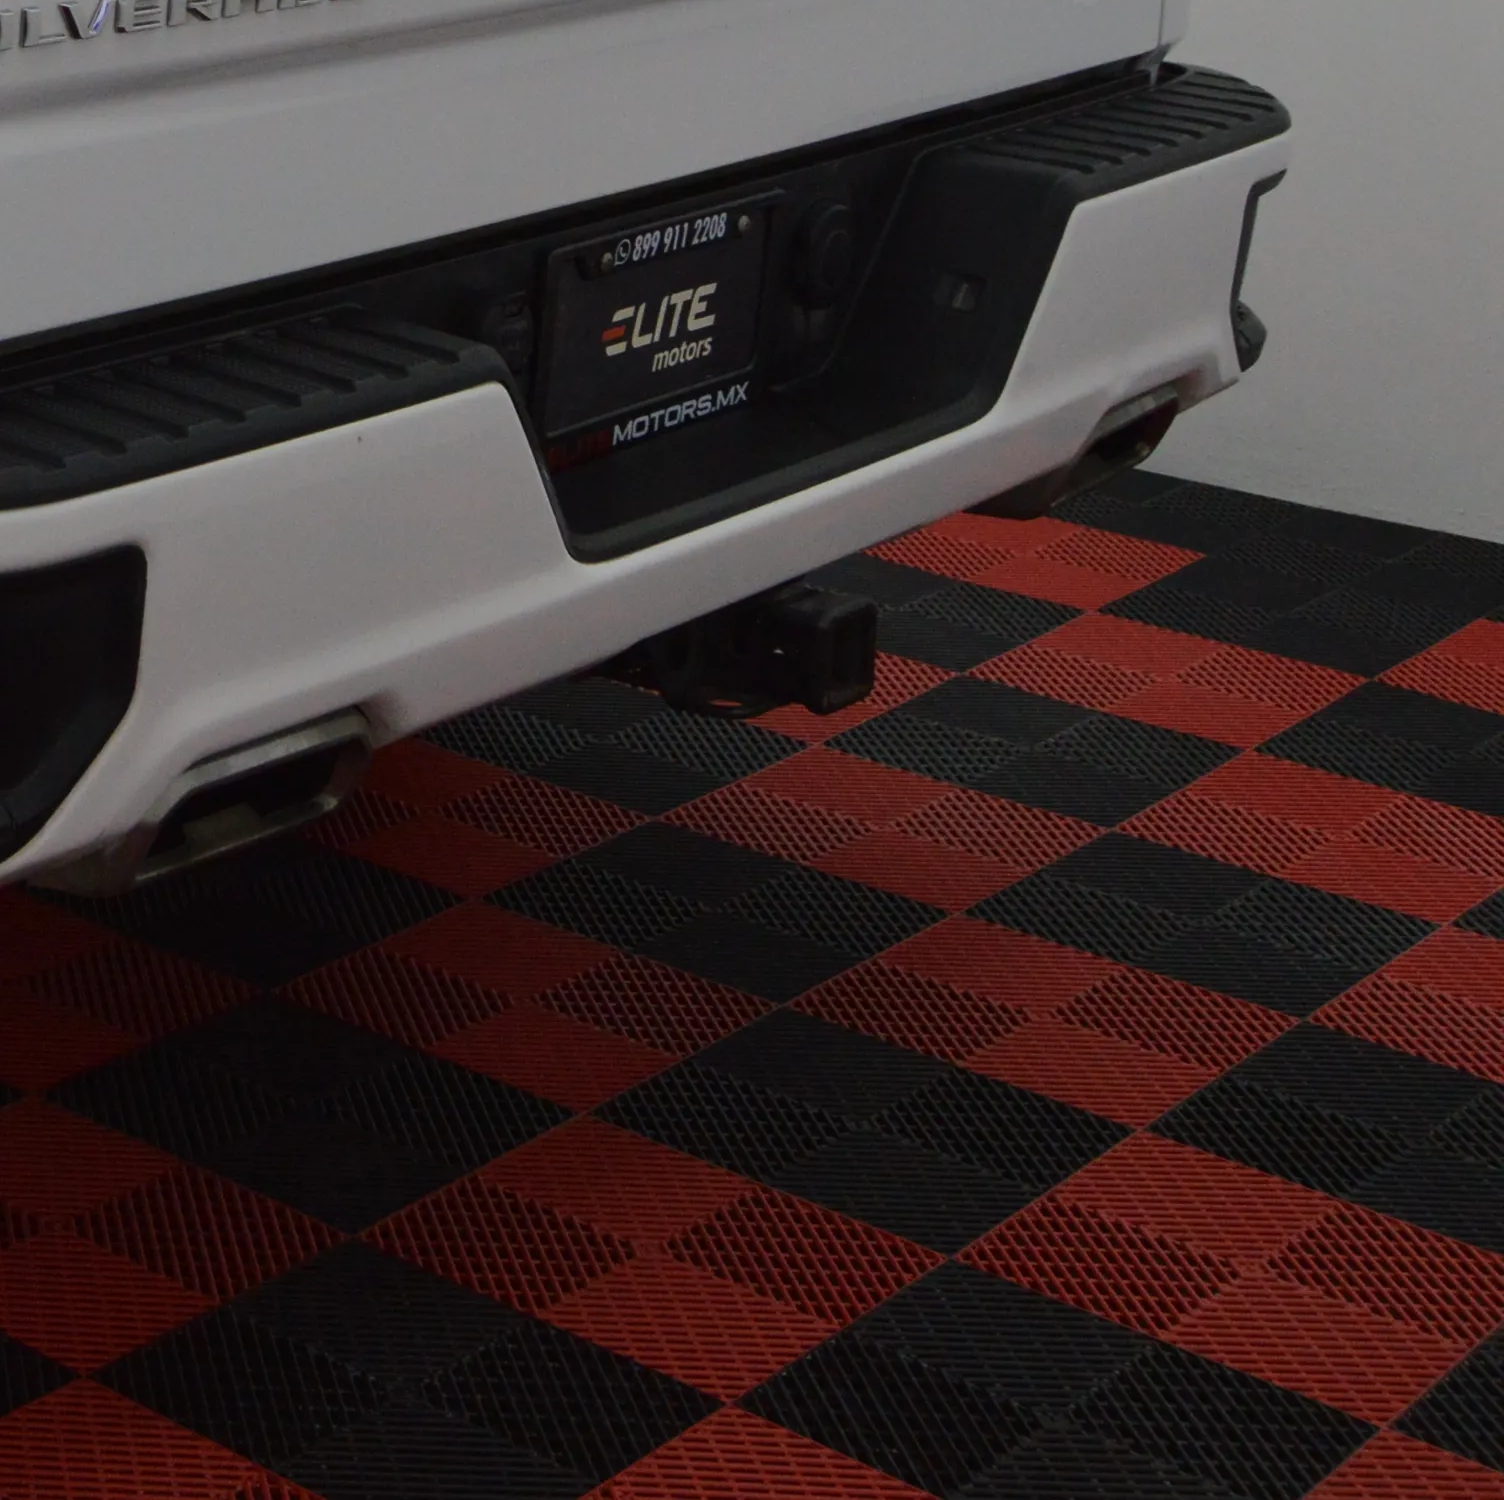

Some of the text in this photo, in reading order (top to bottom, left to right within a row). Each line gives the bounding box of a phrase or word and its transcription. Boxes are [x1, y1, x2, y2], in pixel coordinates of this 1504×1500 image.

[631, 211, 728, 262] 899 911 2208
[601, 281, 718, 357] ELITE
[651, 336, 713, 373] motors
